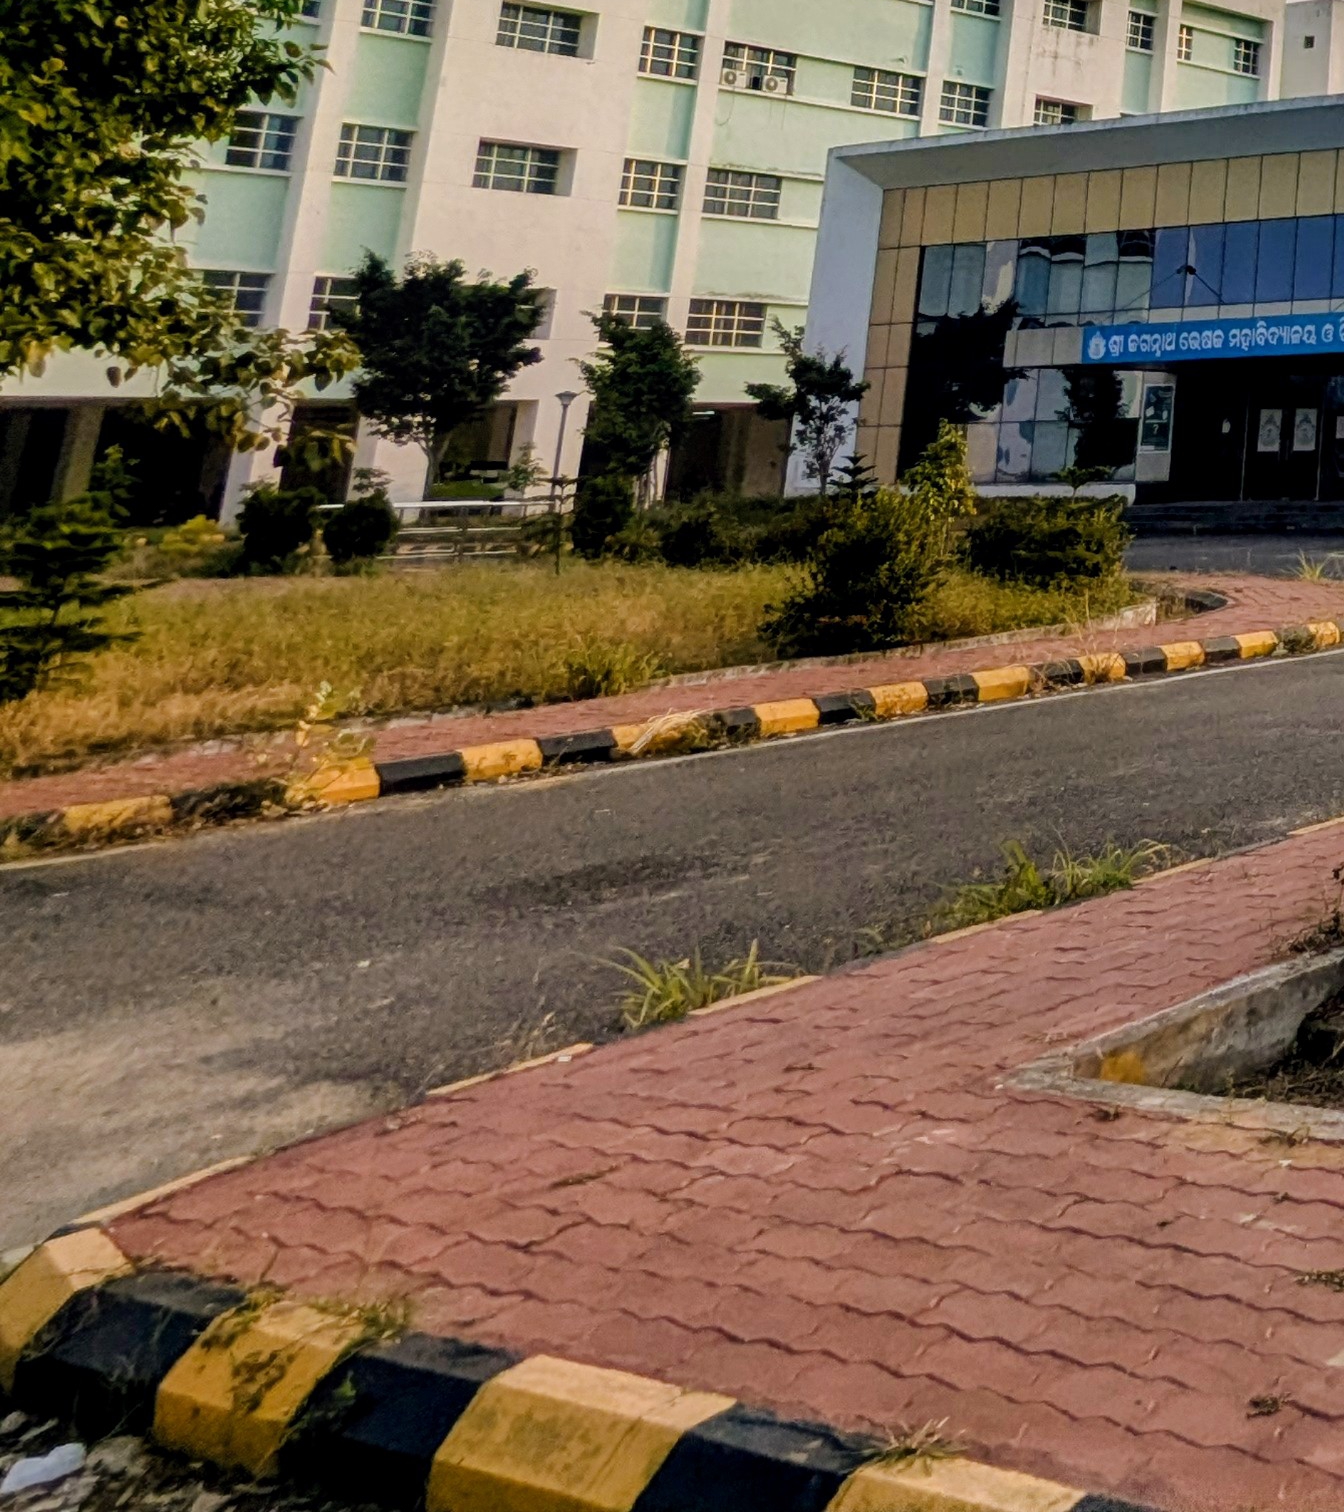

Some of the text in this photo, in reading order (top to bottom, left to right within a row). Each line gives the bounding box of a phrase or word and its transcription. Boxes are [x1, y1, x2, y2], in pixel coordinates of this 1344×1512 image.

[1108, 334, 1124, 356] ଶ୍ରୀ
[1128, 332, 1176, 357] ଜଗନ୍ନାଥ
[1179, 329, 1224, 350] ଭେଷଜ
[1321, 323, 1334, 342] ଓ
